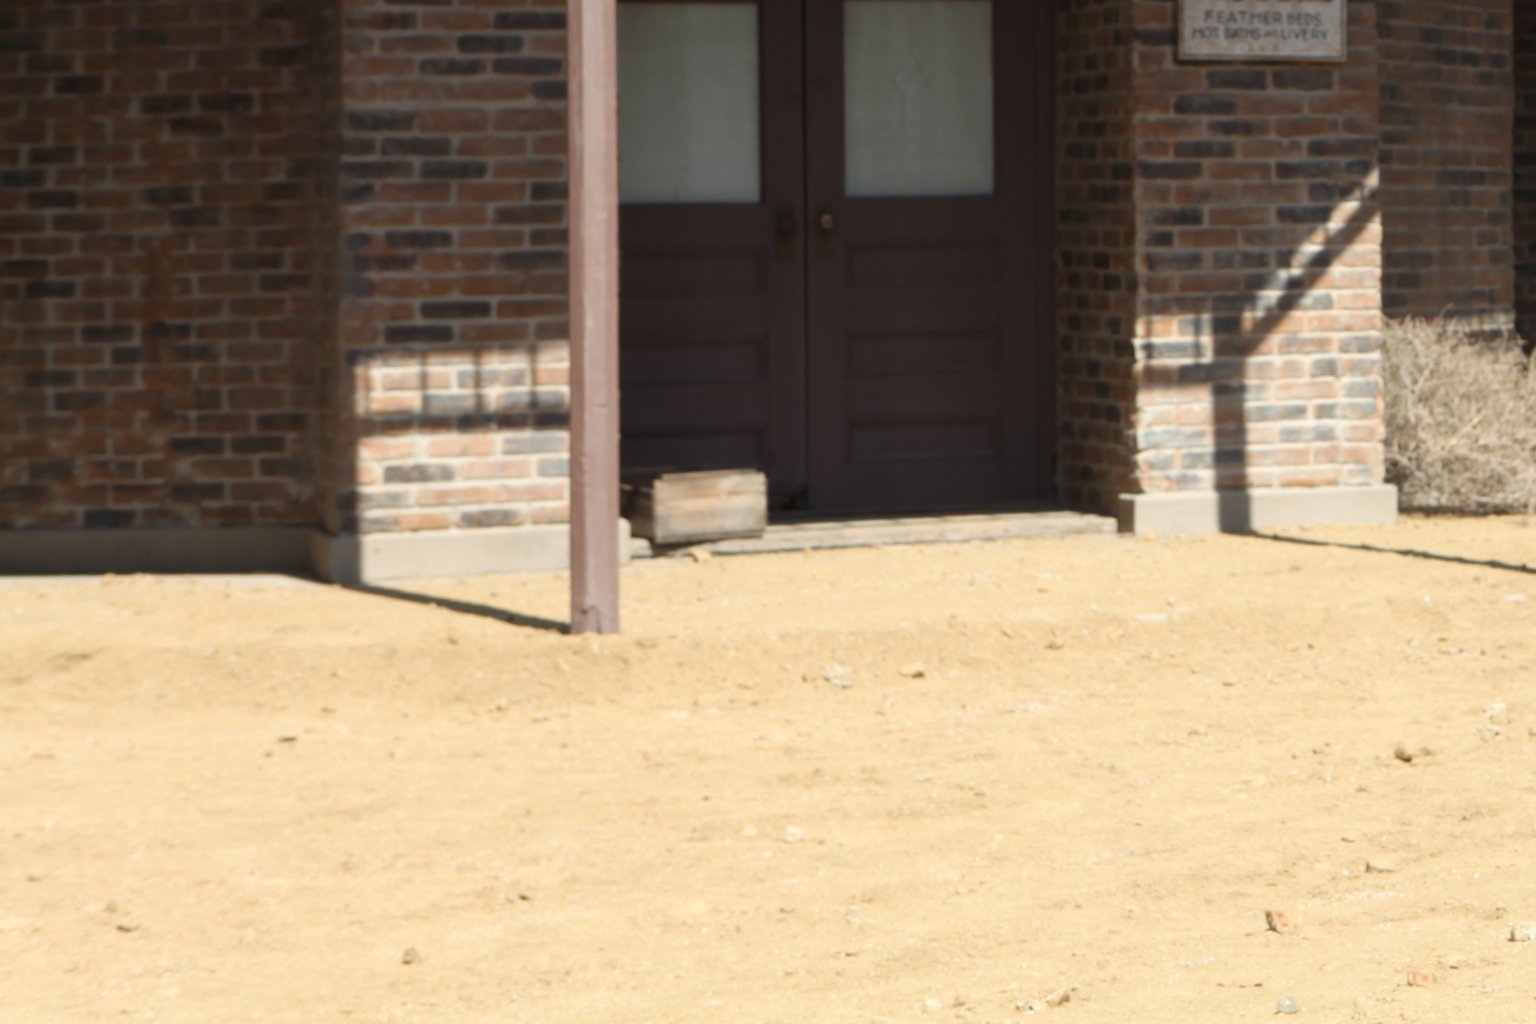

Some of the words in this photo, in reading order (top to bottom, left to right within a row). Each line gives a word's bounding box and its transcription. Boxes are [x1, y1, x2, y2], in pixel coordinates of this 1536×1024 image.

[1203, 10, 1283, 25] FEATHER
[1287, 12, 1323, 27] BEDS
[1191, 27, 1220, 40] HOT
[1224, 27, 1261, 41] BATHS
[1280, 28, 1328, 42] LIVERY
